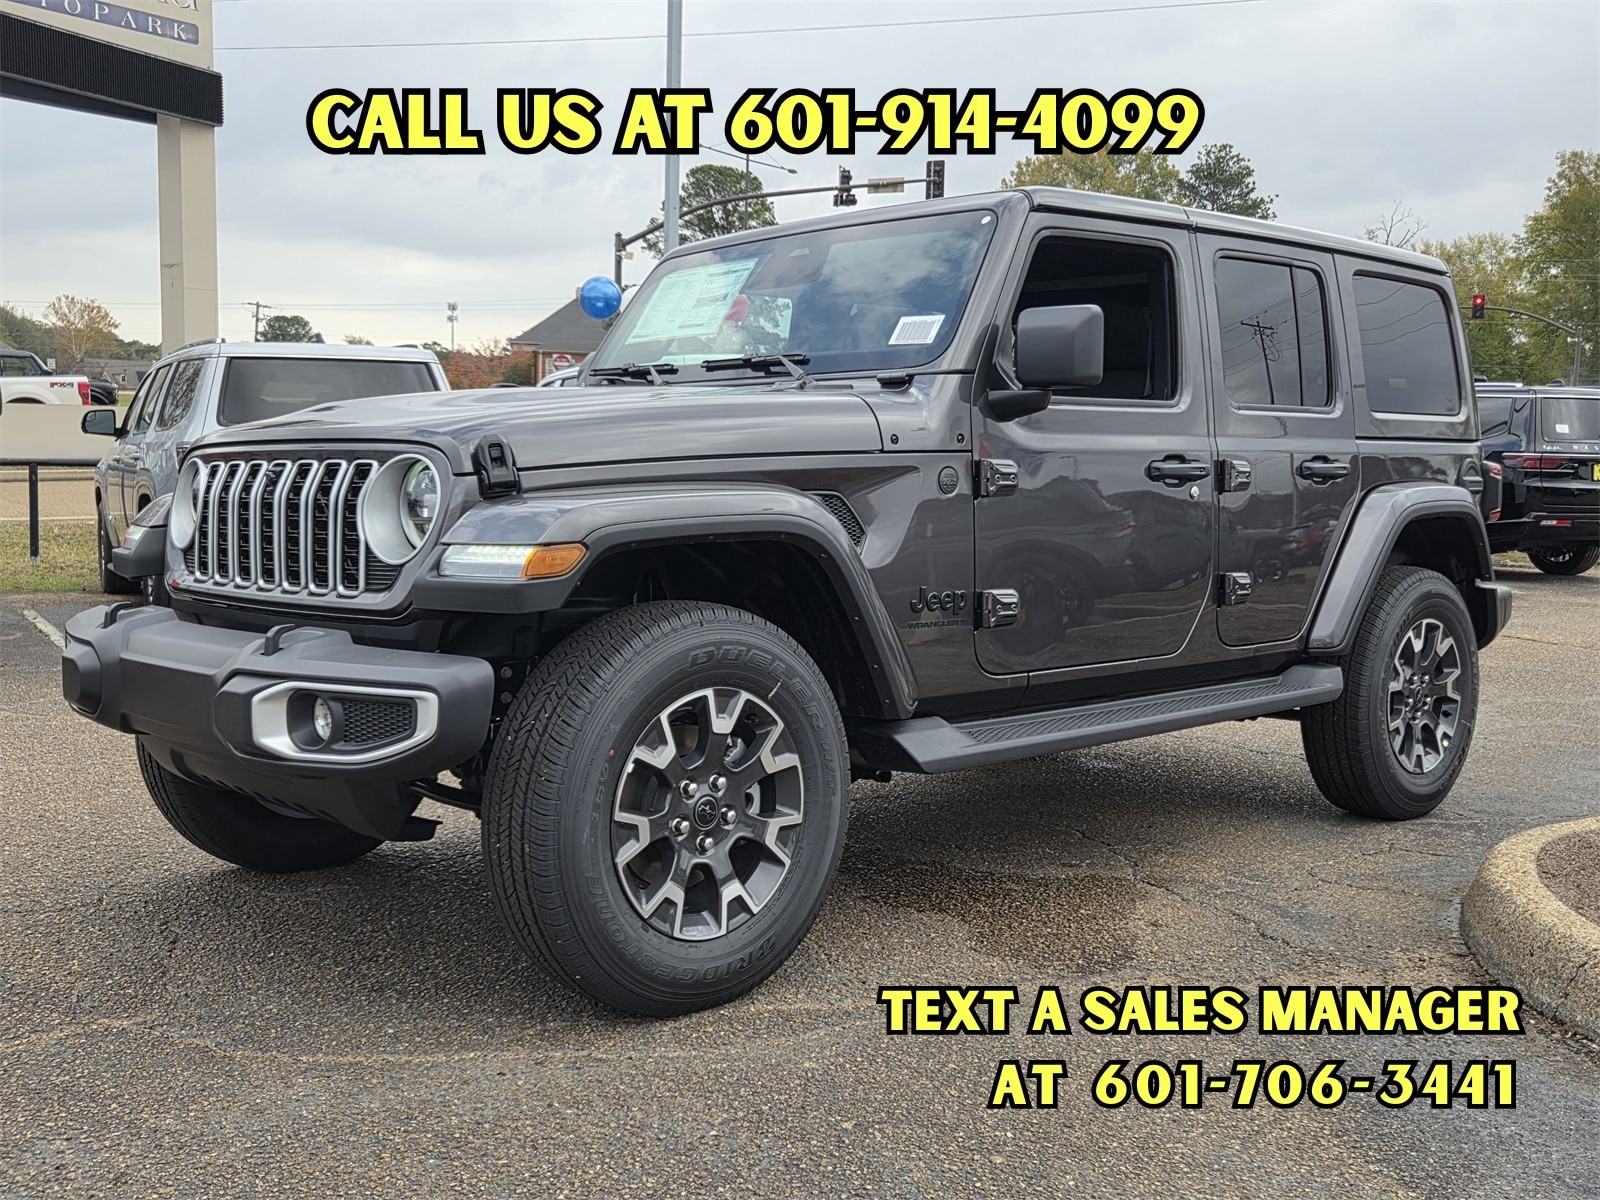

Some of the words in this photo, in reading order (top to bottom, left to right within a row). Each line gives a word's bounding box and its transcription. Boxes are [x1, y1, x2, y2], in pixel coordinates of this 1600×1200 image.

[906, 619, 960, 630] WRANGLER
[910, 585, 968, 616] Jeep
[687, 644, 828, 733] DUELER
[585, 873, 777, 984] BRIDGESTONE
